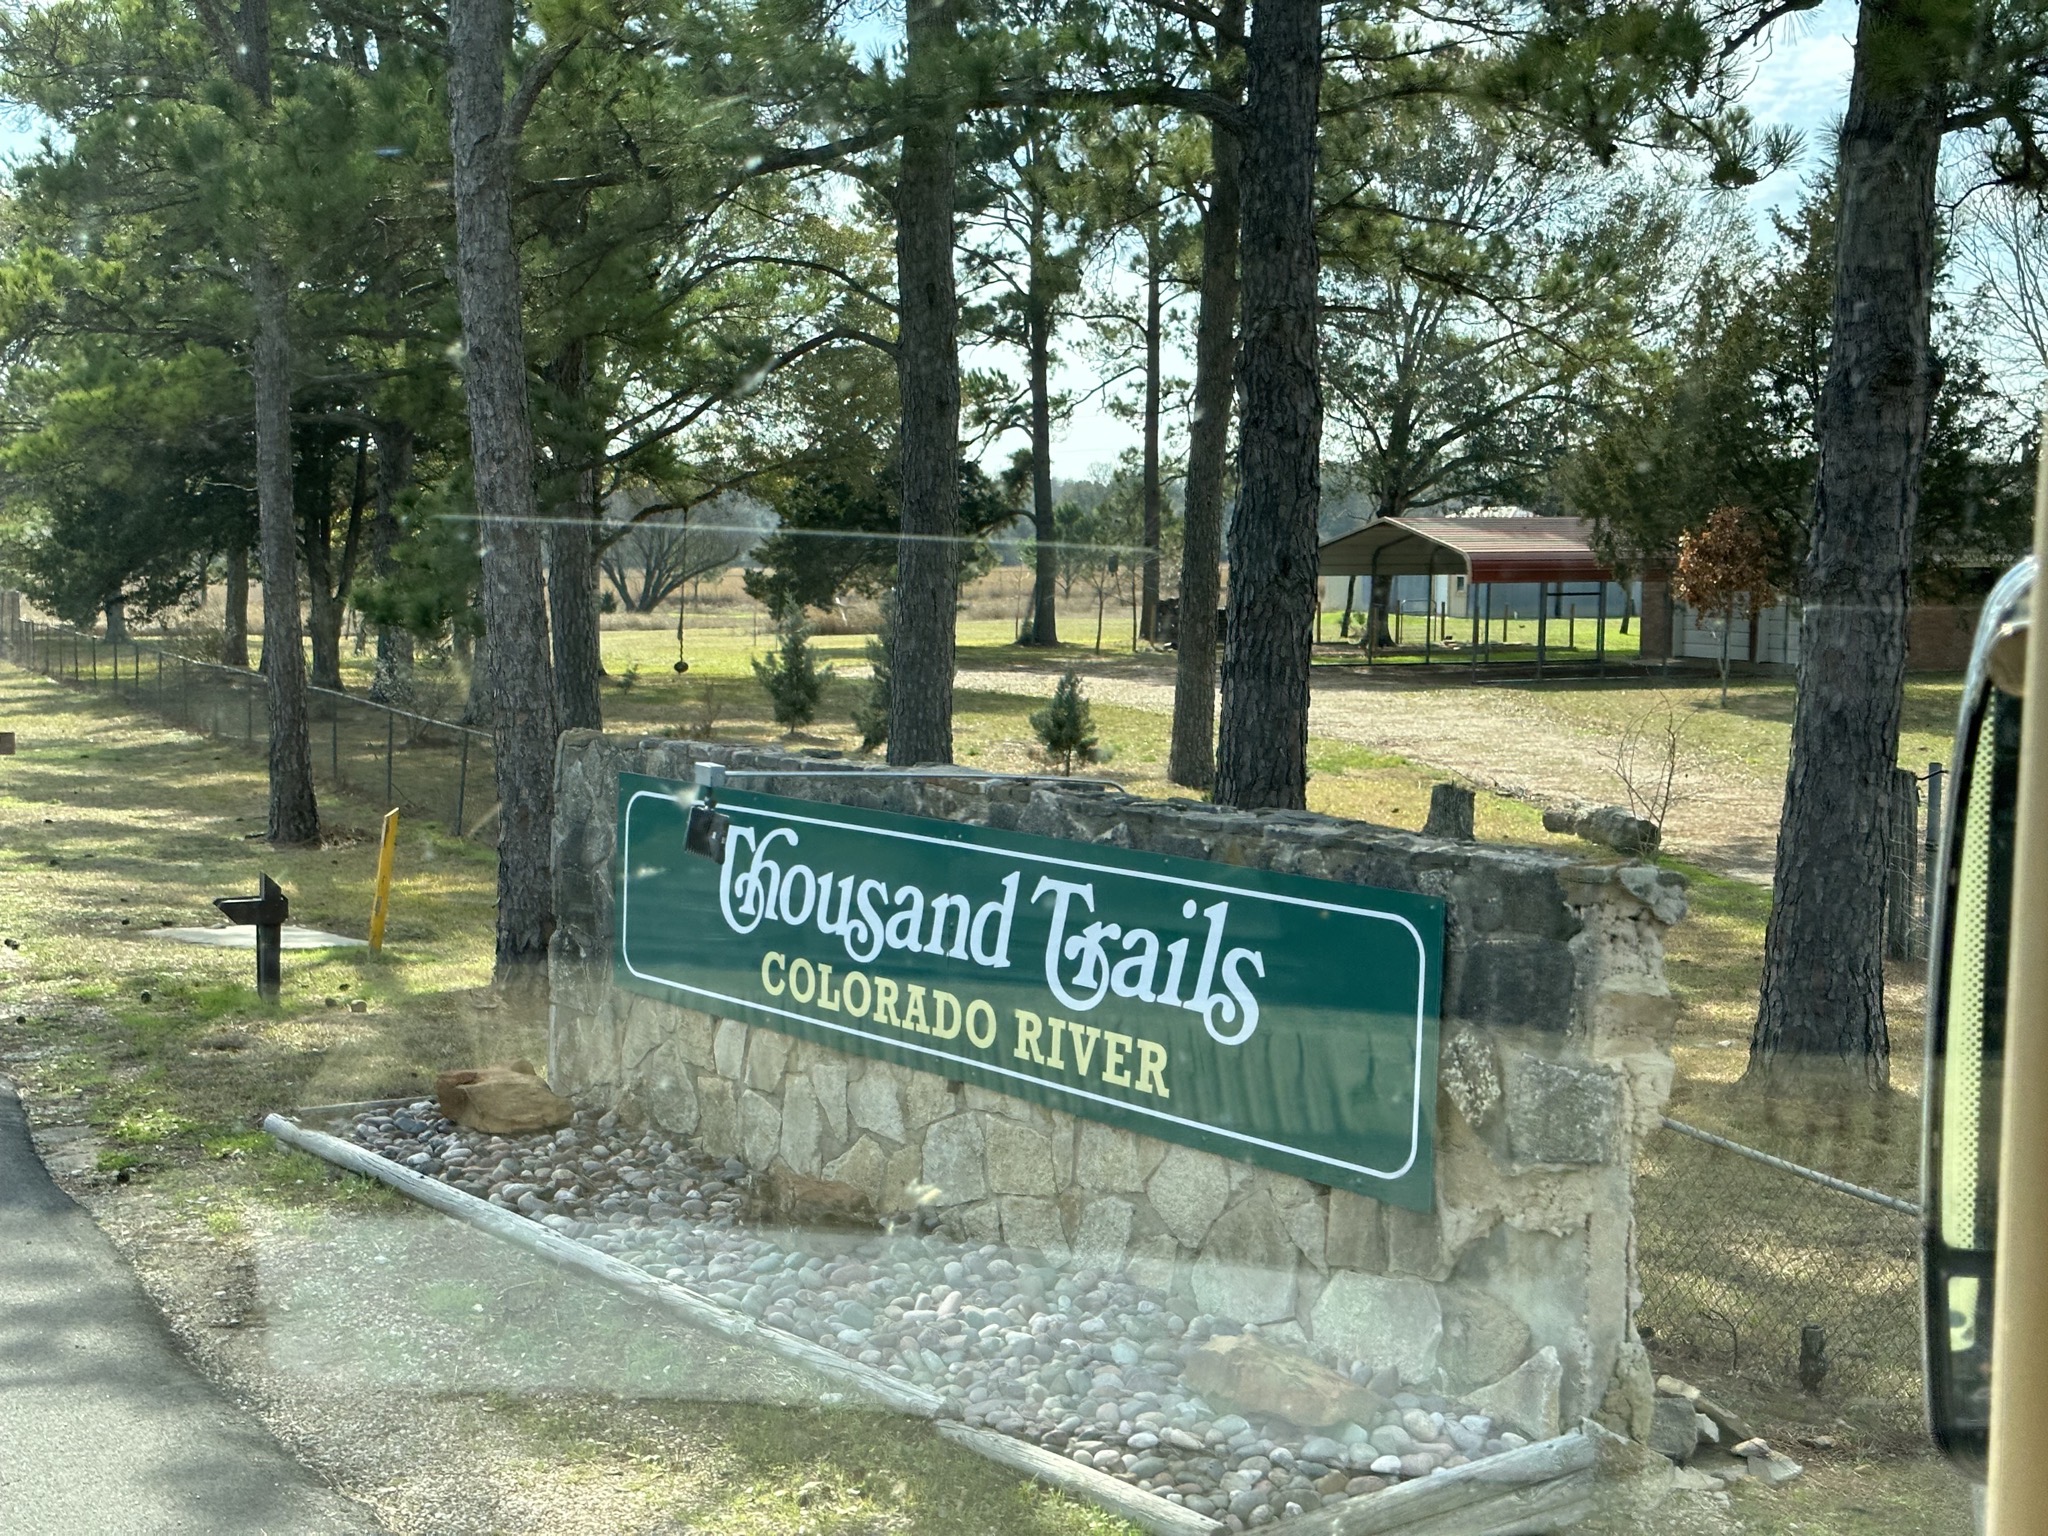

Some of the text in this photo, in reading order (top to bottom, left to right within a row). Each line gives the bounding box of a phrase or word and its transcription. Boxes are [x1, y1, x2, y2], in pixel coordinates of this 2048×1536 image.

[719, 825, 1266, 1046] Thousand Trails
[760, 951, 1171, 1098] COLORADO RIVER
